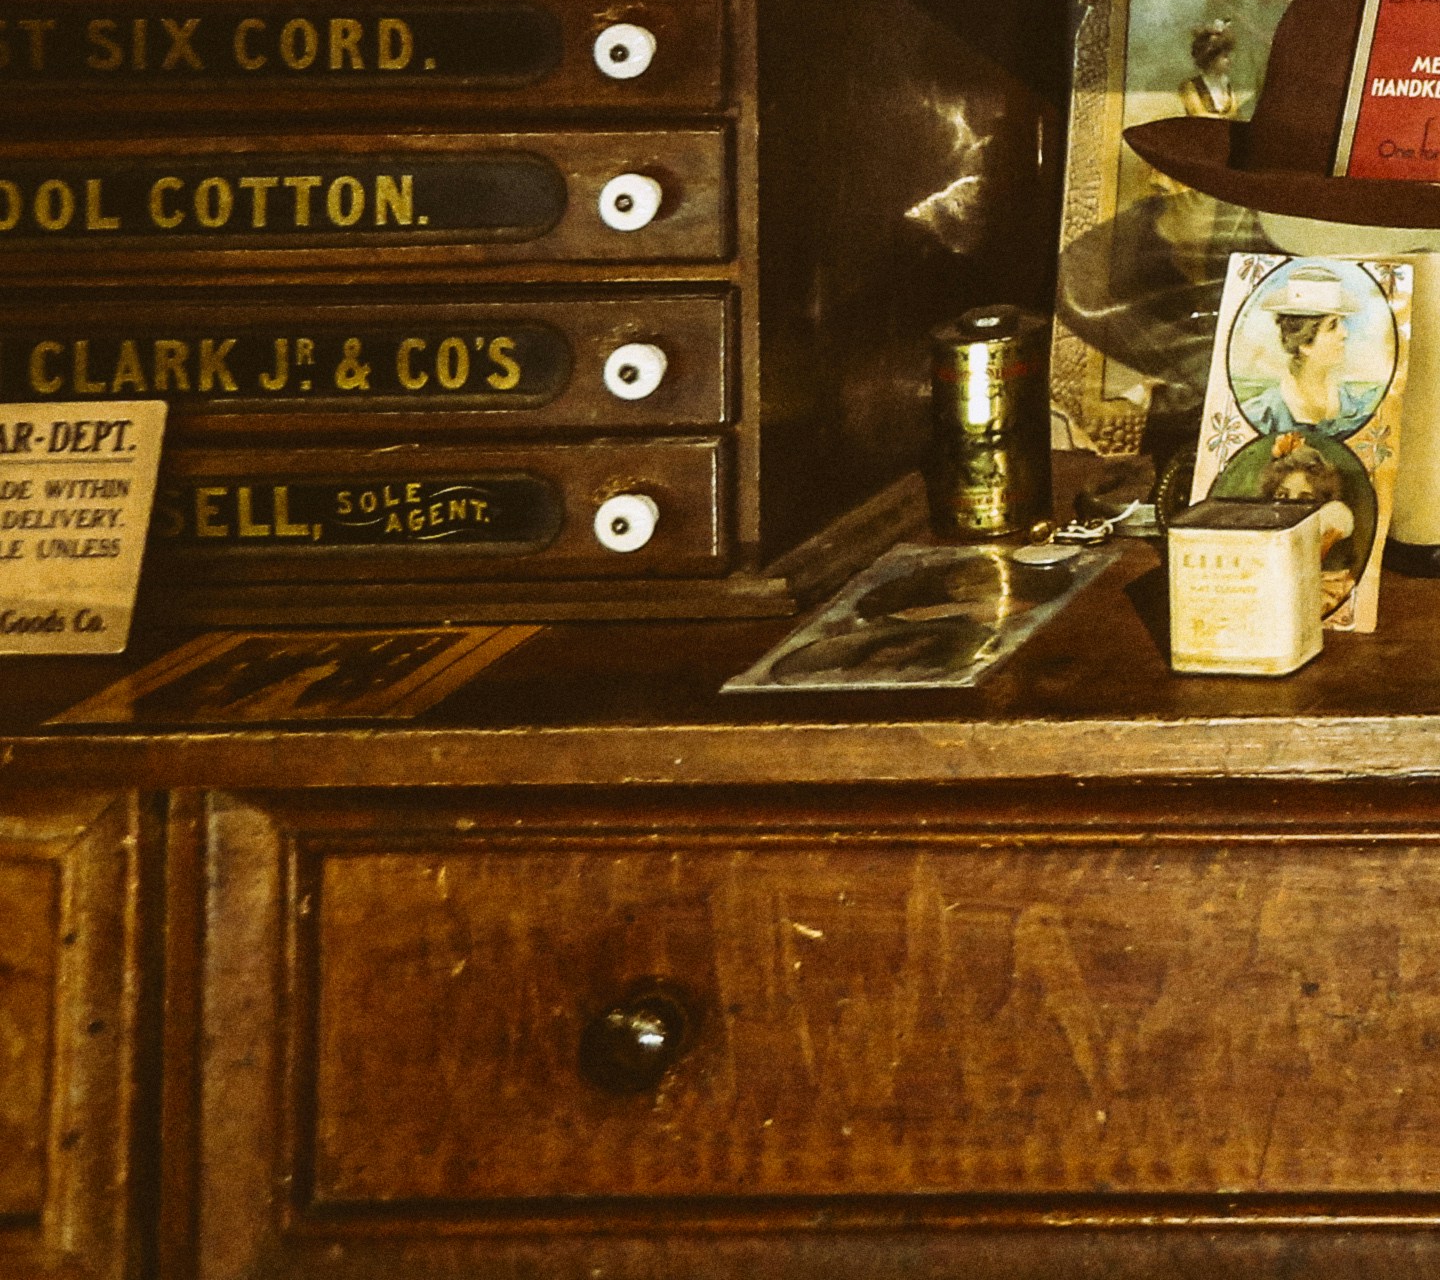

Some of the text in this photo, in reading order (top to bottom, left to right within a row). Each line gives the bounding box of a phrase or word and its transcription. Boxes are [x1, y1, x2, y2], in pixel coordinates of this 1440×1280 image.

[87, 18, 438, 71] SIX CORD.
[148, 174, 429, 228] COTTON.
[29, 339, 239, 394] CLARK
[333, 339, 370, 390] &
[398, 336, 522, 390] CO'S
[3, 508, 125, 529] DELIVERY.
[335, 483, 423, 514] SOLE
